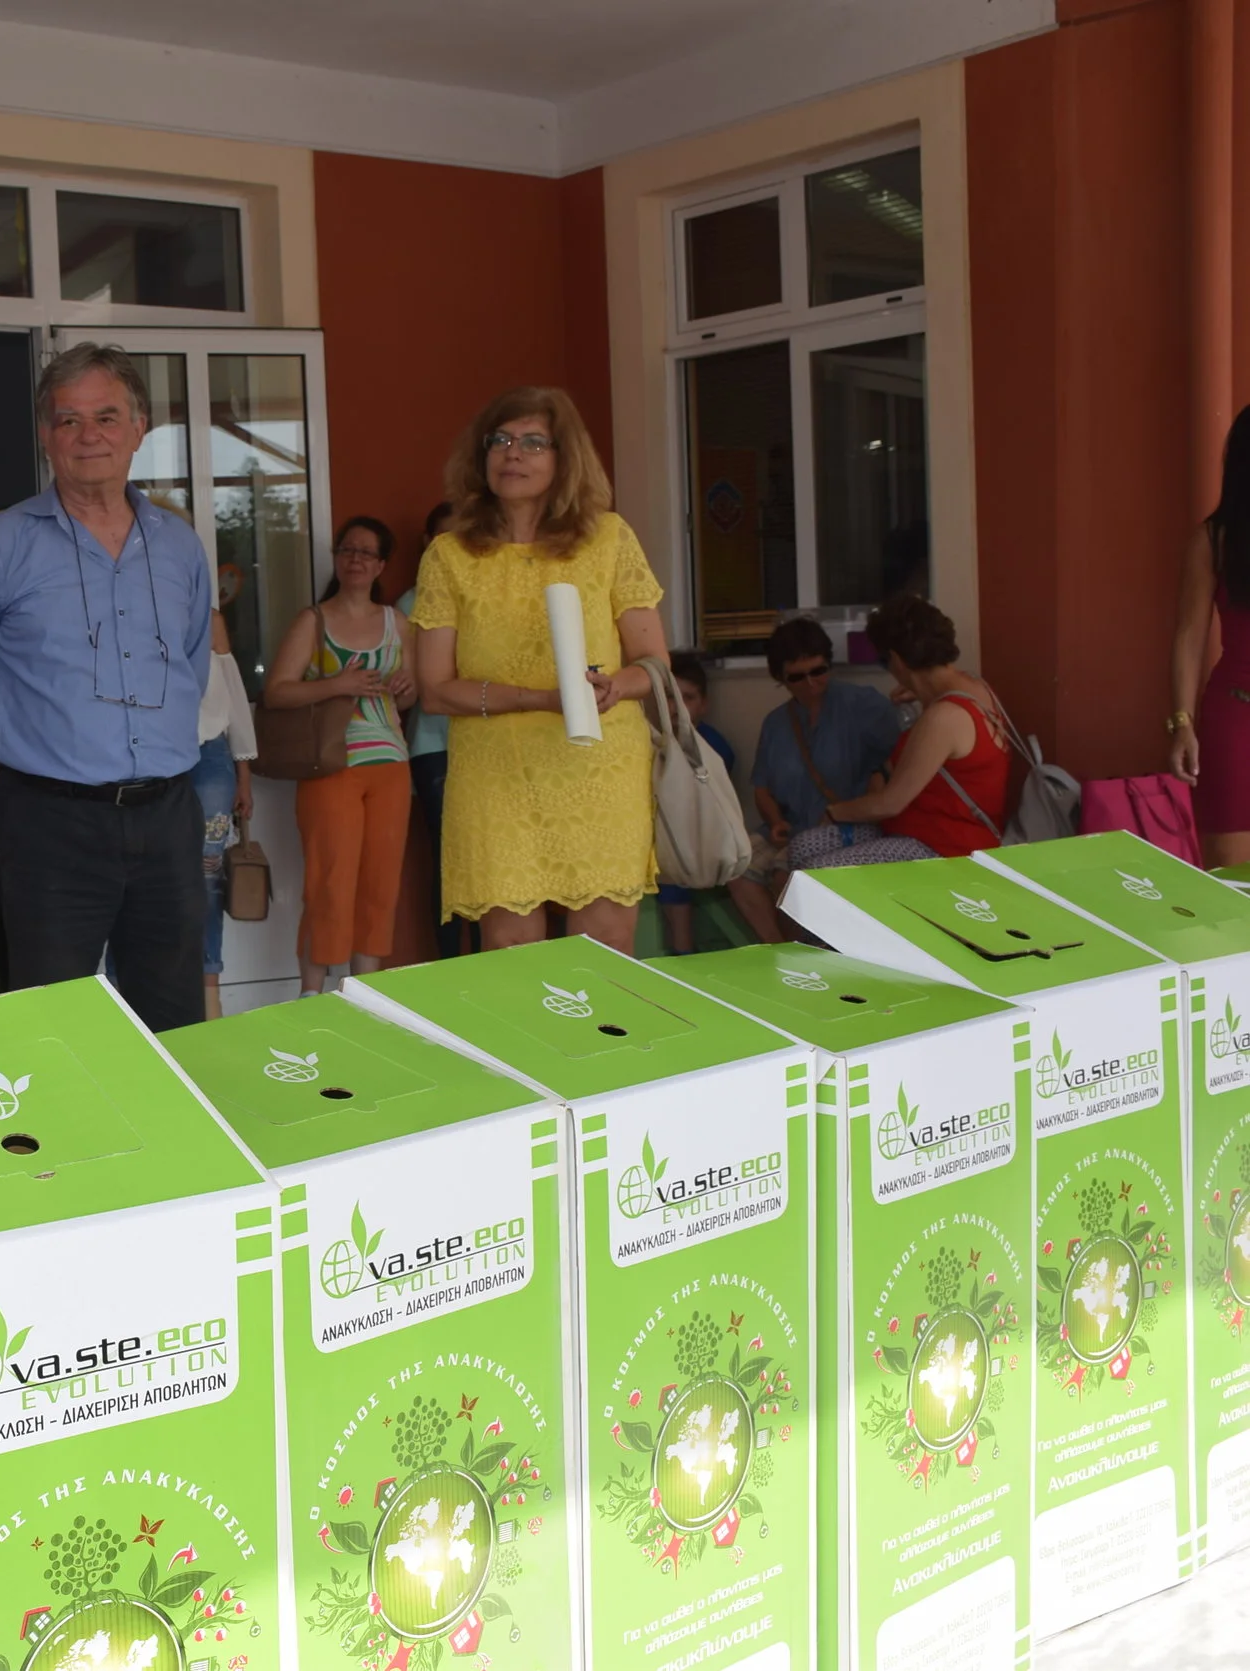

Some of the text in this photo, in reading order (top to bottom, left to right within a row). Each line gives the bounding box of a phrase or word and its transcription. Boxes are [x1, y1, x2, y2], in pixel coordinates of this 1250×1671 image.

[1063, 1049, 1158, 1088] va.ste.eco
[1068, 1067, 1159, 1105] EVOLUTION
[910, 1102, 1010, 1147] va.ste.eco
[1086, 1098, 1120, 1117] ΔΙΑΧΕΙΡΙΣΗ
[1121, 1087, 1159, 1107] ΑΠΟΒΛΗΤΩΝ
[878, 1170, 927, 1197] ΑΝΑΚΥΚΛΩΣΗ
[934, 1155, 970, 1179] ΔΙΑΧΕΙΡΙΣΗ
[971, 1143, 1011, 1166] ΑΠΟΒΛΗΤΩΝ
[914, 1123, 1011, 1166] EVOLUTION
[656, 1151, 781, 1204] va.ste.eco
[663, 1174, 782, 1224] EVOLUTION
[1037, 1148, 1175, 1228] ΟΣΜΟΣ ΤΗΣ ΑΝΑΚΥΚΛΩΣΗΣ
[368, 1217, 525, 1280] va.ste.eco
[617, 1229, 676, 1259] ΑΝΑΚΥΚΛΩΣΗ
[686, 1211, 731, 1238] ΔΙΑΧΕΙΡΙΣΗ
[733, 1195, 782, 1222] ΑΠΟΒΛΗΤΩΝ
[376, 1242, 526, 1303] EVOLUTION
[873, 1241, 918, 1318] ΚΟΣΜΟΣ
[922, 1217, 947, 1241] ΤΗΣ
[952, 1212, 1023, 1284] ΑΝΑΚΥΚΛΩΣΗΣ
[321, 1307, 393, 1344] ΑΝΑΚΥΚΛΩΣΗ
[405, 1286, 461, 1317] ΔΙΑΧΕΙΡΙΣΗ
[464, 1266, 525, 1297] ΑΠΟΒΛΗΤΩΝ
[612, 1306, 665, 1391] ΚΟΣΜΟΣ
[671, 1279, 701, 1305] ΤΗΣ
[709, 1273, 798, 1349] ΑΝΑΚΥΚΛΩΣΗΣ
[10, 1318, 226, 1383] va.ste.eco
[21, 1347, 228, 1410] EVOLUTION
[62, 1392, 139, 1425] ΔΙΑΧΕΙΡΙΣΗ
[143, 1373, 227, 1406] ΑΠΟΒΛΗΤΩΝ
[318, 1392, 380, 1490] ΚΟΣΜΟΣ
[387, 1361, 423, 1390] ΤΗΣ
[434, 1352, 547, 1433] ΑΝΑΚΥΚΛΩΣΗΣ
[38, 1476, 87, 1508] ΤΗΣ
[102, 1468, 256, 1561] ΑΝΑΚΥΚΛΩΣΗΣ
